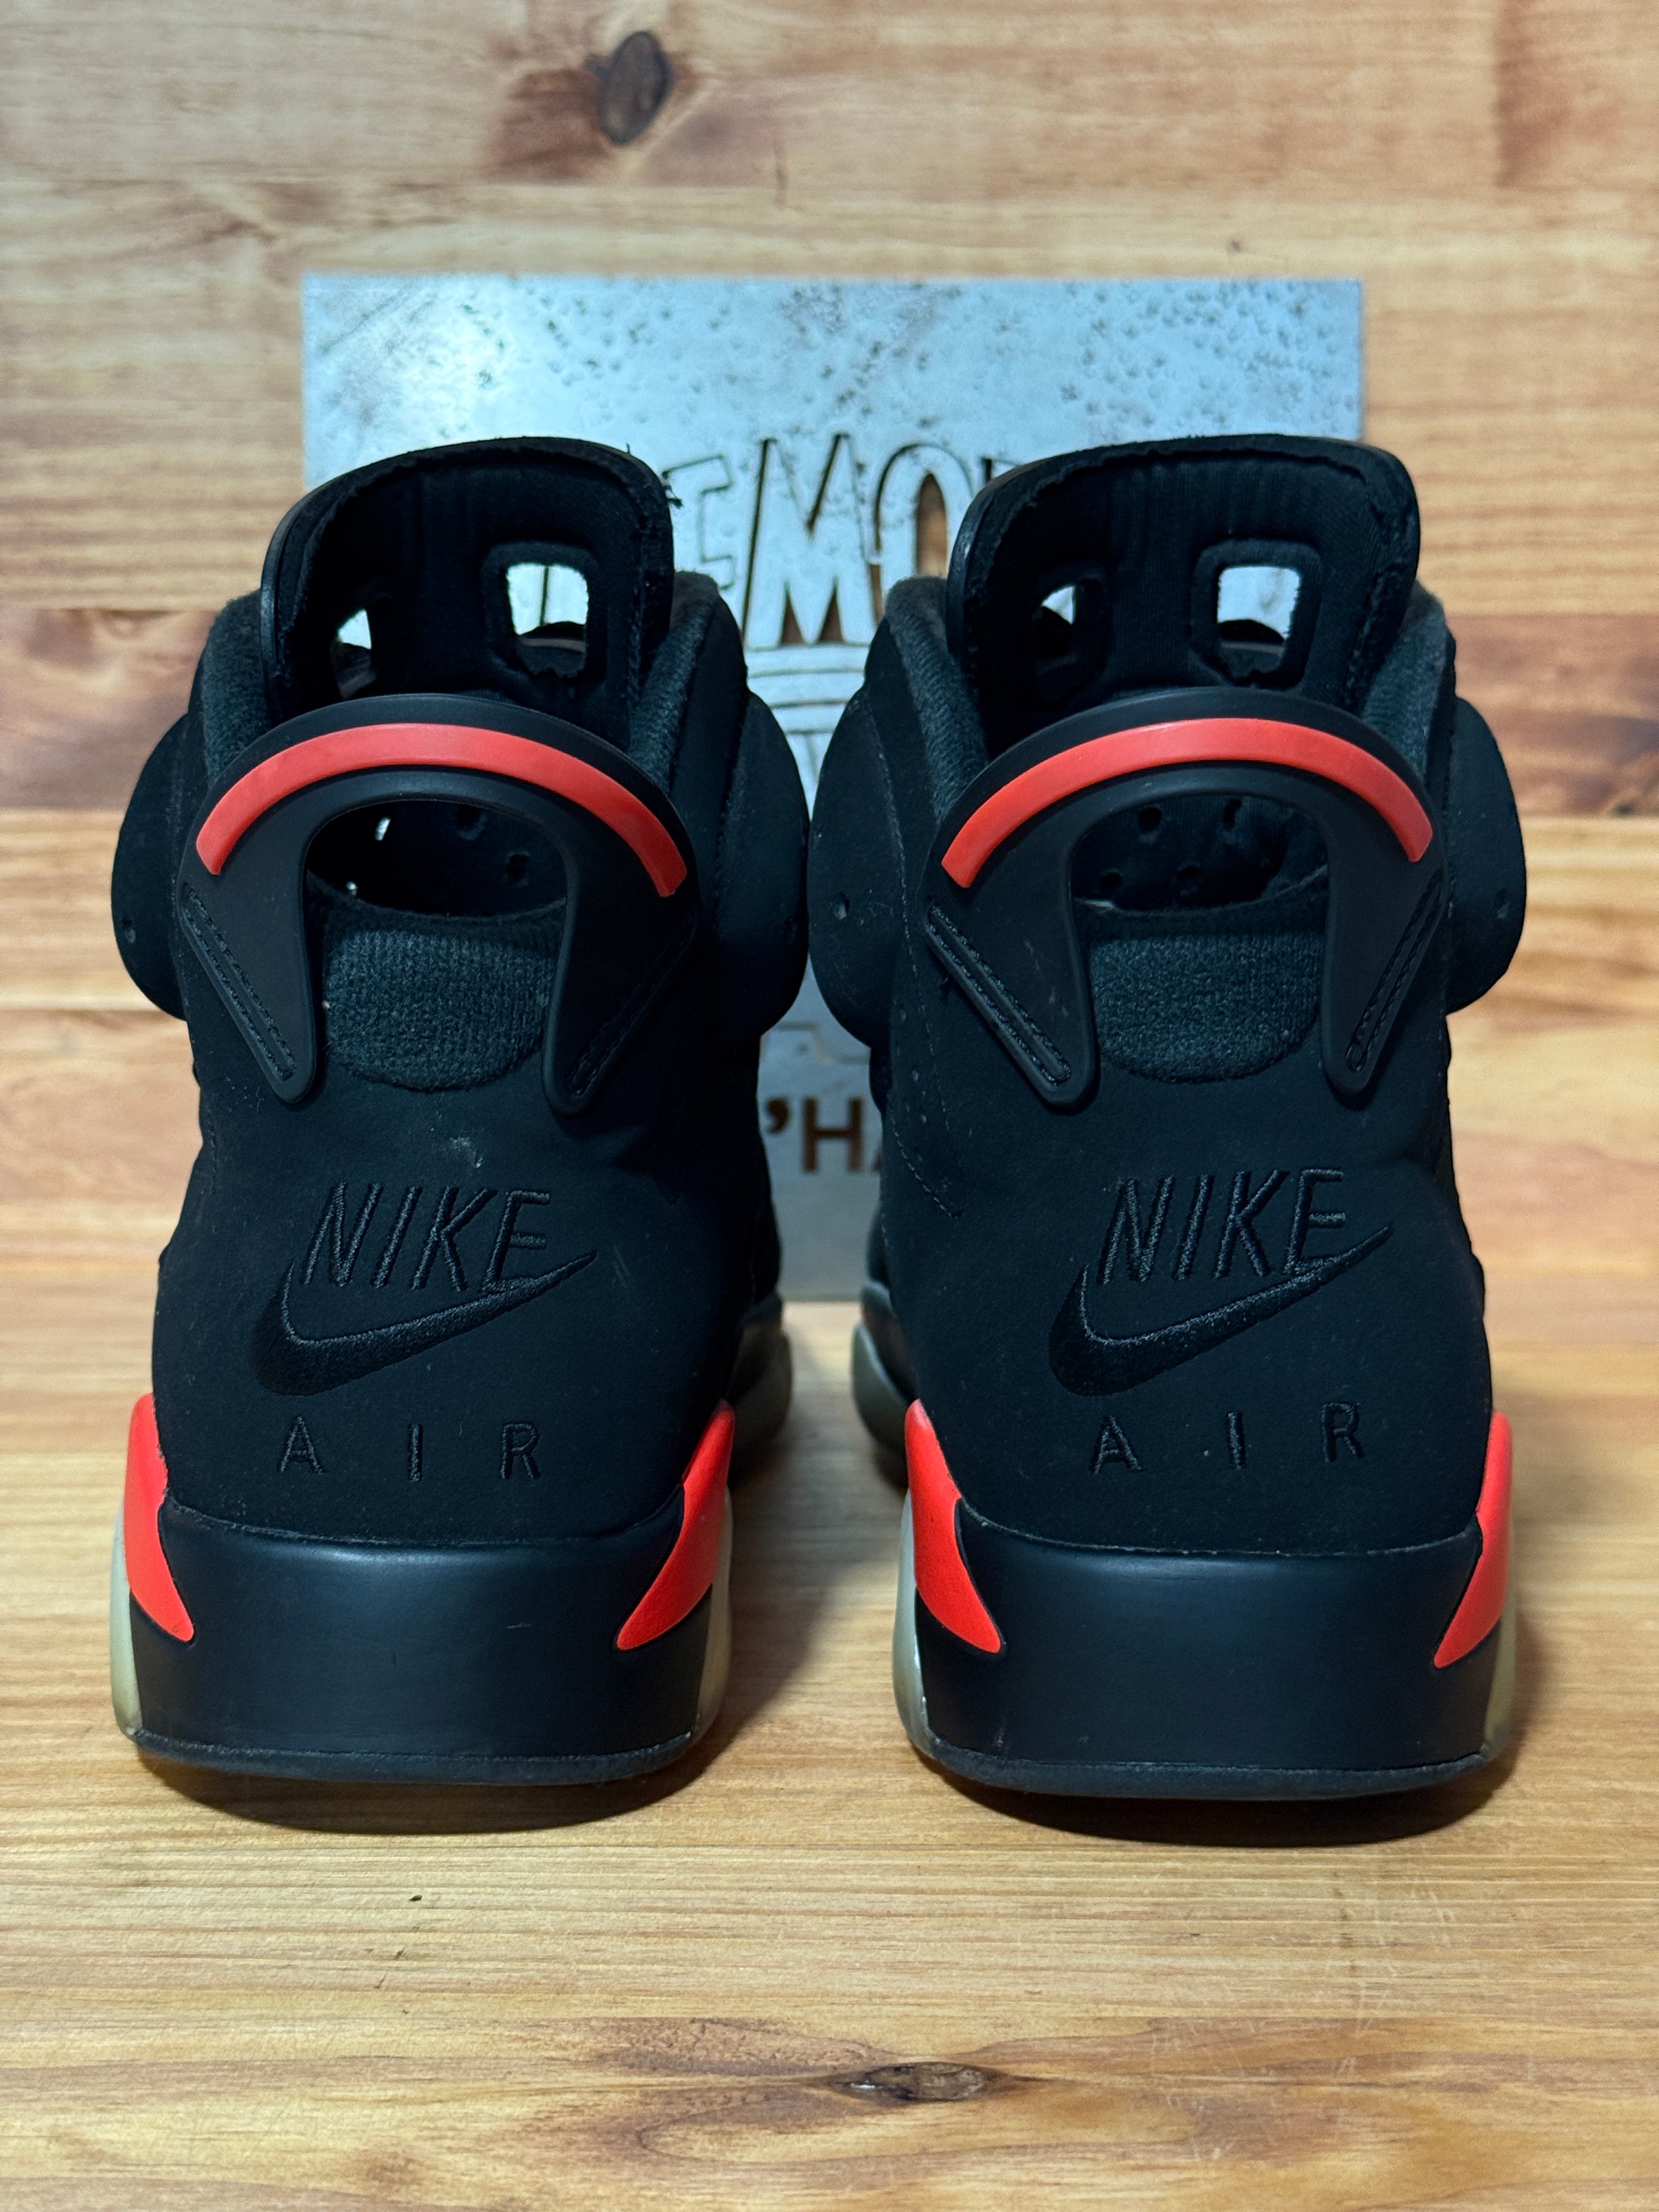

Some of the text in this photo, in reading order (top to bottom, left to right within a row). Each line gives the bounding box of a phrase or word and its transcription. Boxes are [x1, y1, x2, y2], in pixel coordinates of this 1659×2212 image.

[662, 433, 1025, 648] EMO
[300, 1181, 550, 1293] NIKE
[1097, 1167, 1346, 1285] NIKE
[276, 1415, 542, 1482] AIR
[1089, 1401, 1364, 1474] AIR
